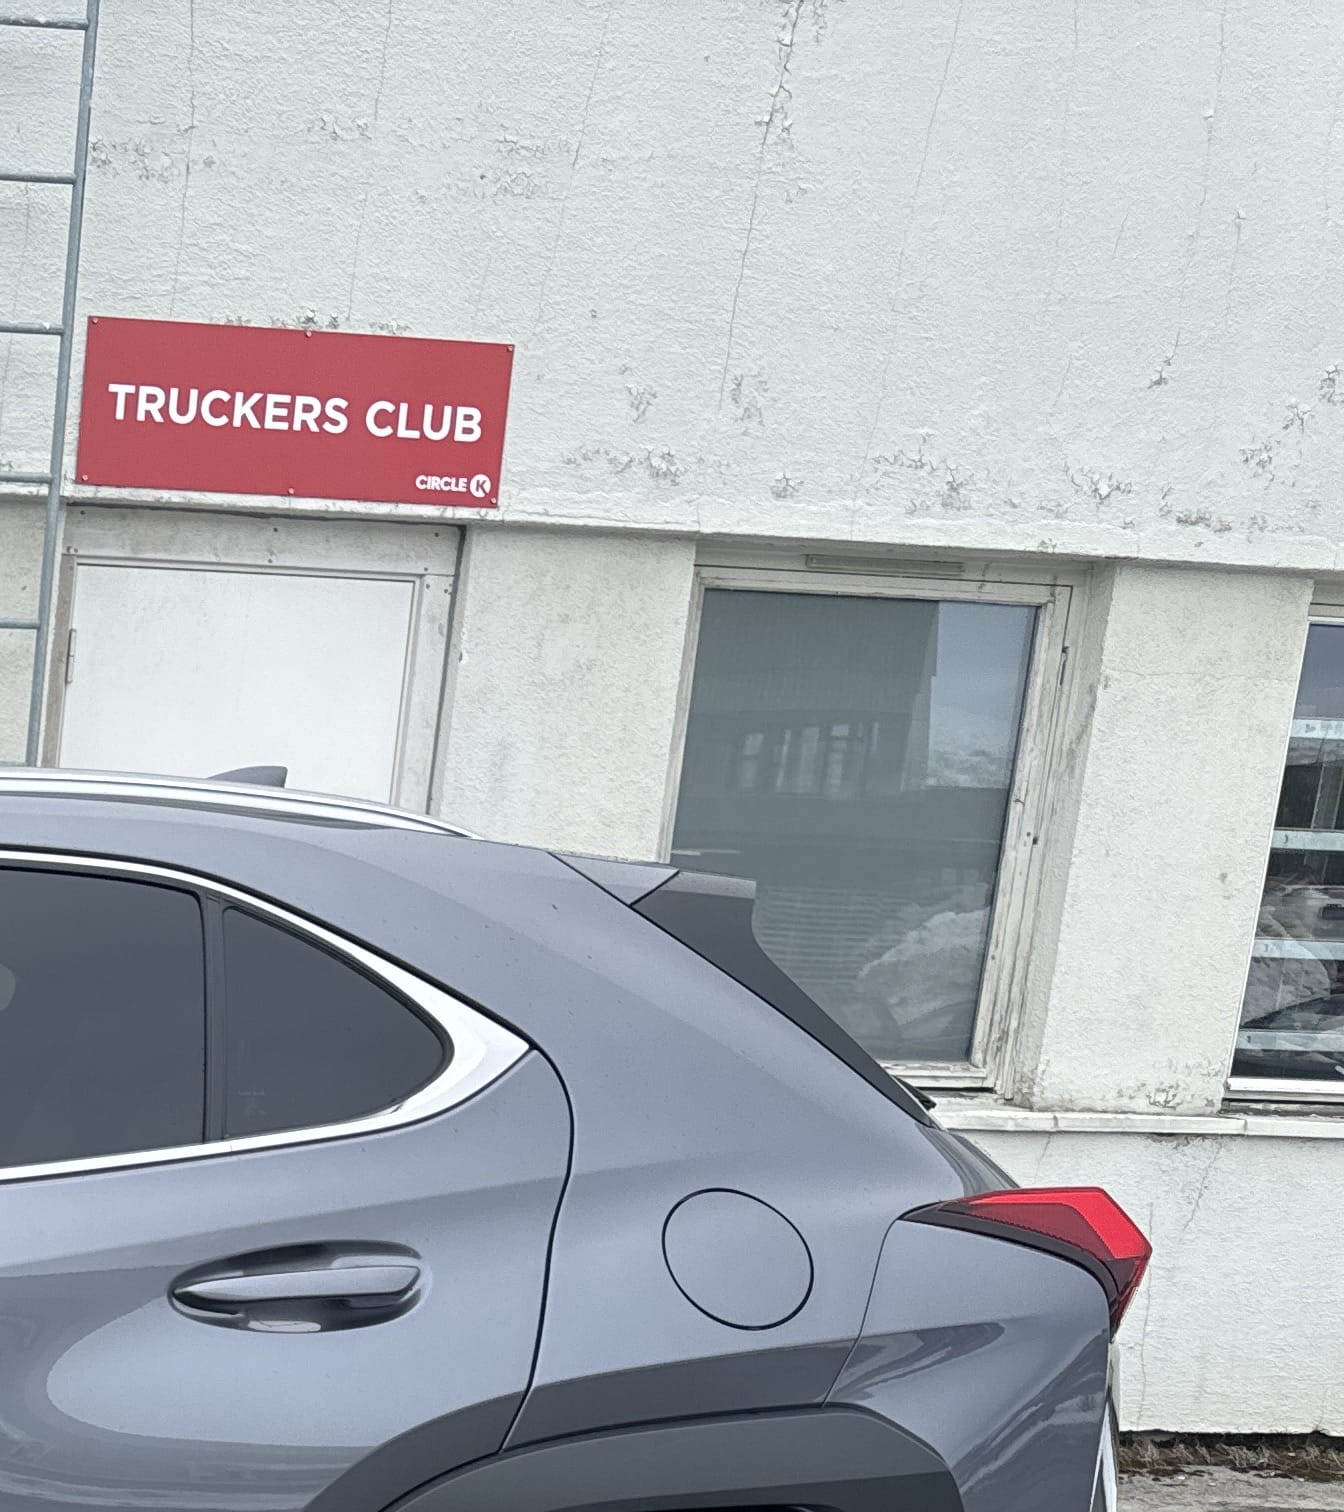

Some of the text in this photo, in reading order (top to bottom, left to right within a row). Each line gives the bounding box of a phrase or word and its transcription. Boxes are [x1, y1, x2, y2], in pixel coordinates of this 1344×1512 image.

[108, 382, 482, 442] TRUCKERS CLUB
[415, 474, 491, 496] CIRCLE K
